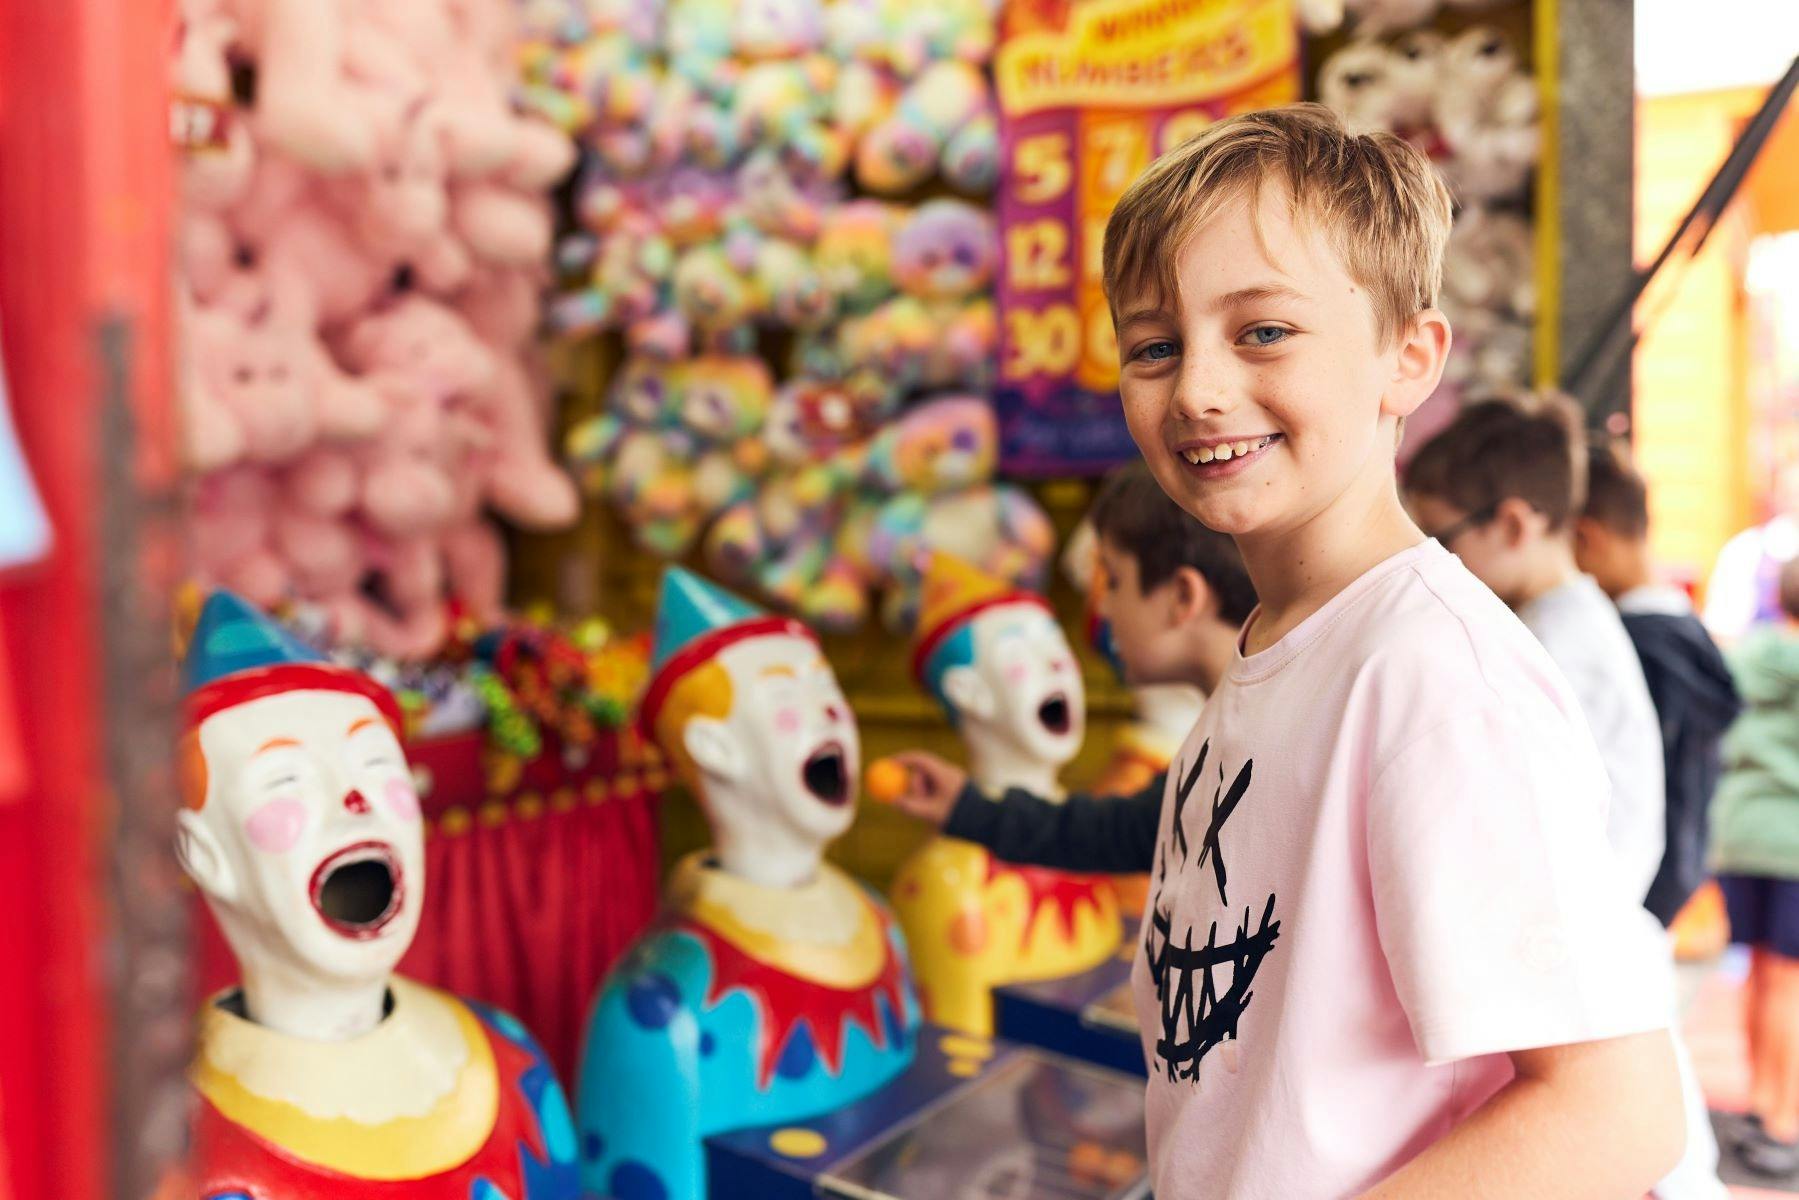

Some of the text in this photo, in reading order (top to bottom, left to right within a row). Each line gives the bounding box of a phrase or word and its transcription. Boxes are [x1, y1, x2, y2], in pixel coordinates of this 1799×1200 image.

[1014, 134, 1070, 202] 5
[1086, 123, 1141, 188] 7
[1006, 220, 1070, 287] 12
